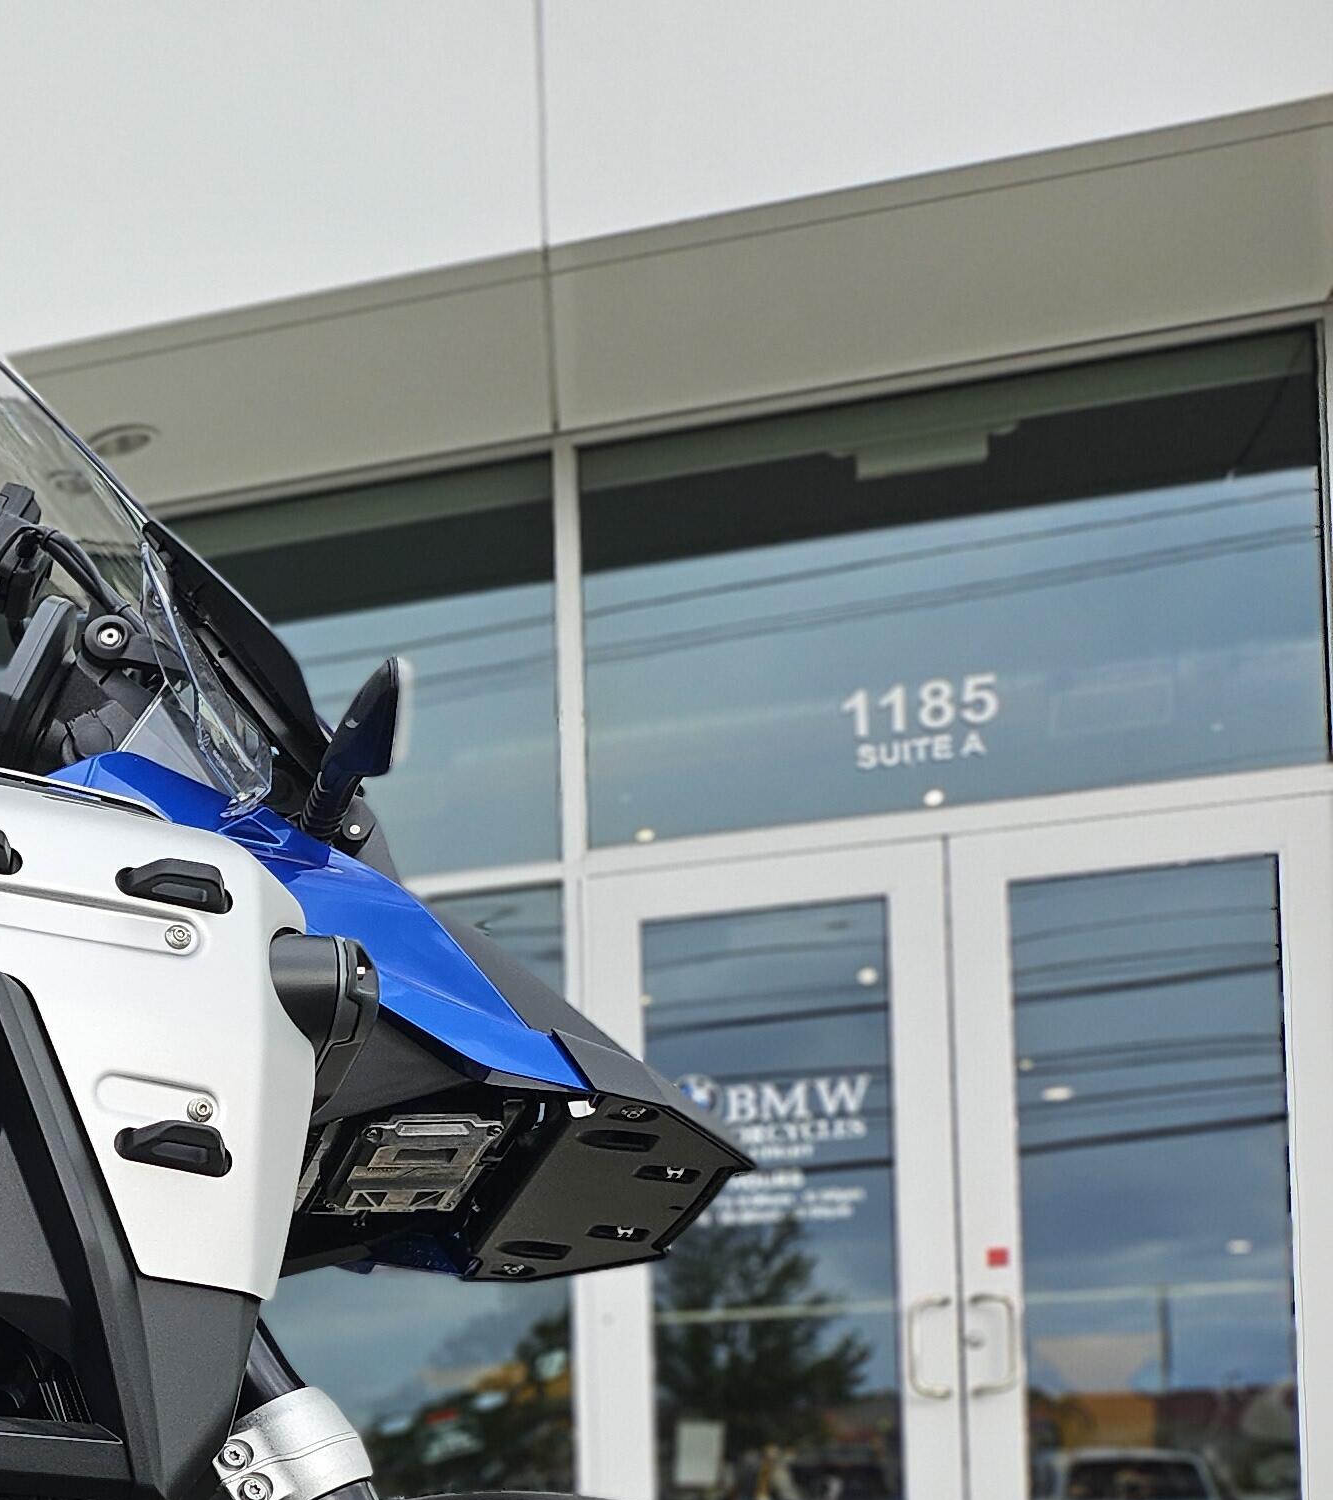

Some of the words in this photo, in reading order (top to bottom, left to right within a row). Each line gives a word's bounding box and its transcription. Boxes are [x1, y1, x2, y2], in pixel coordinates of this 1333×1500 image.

[841, 673, 1000, 738] 1185
[856, 734, 954, 770] SUITE
[961, 731, 986, 757] A
[725, 1073, 871, 1124] BMW
